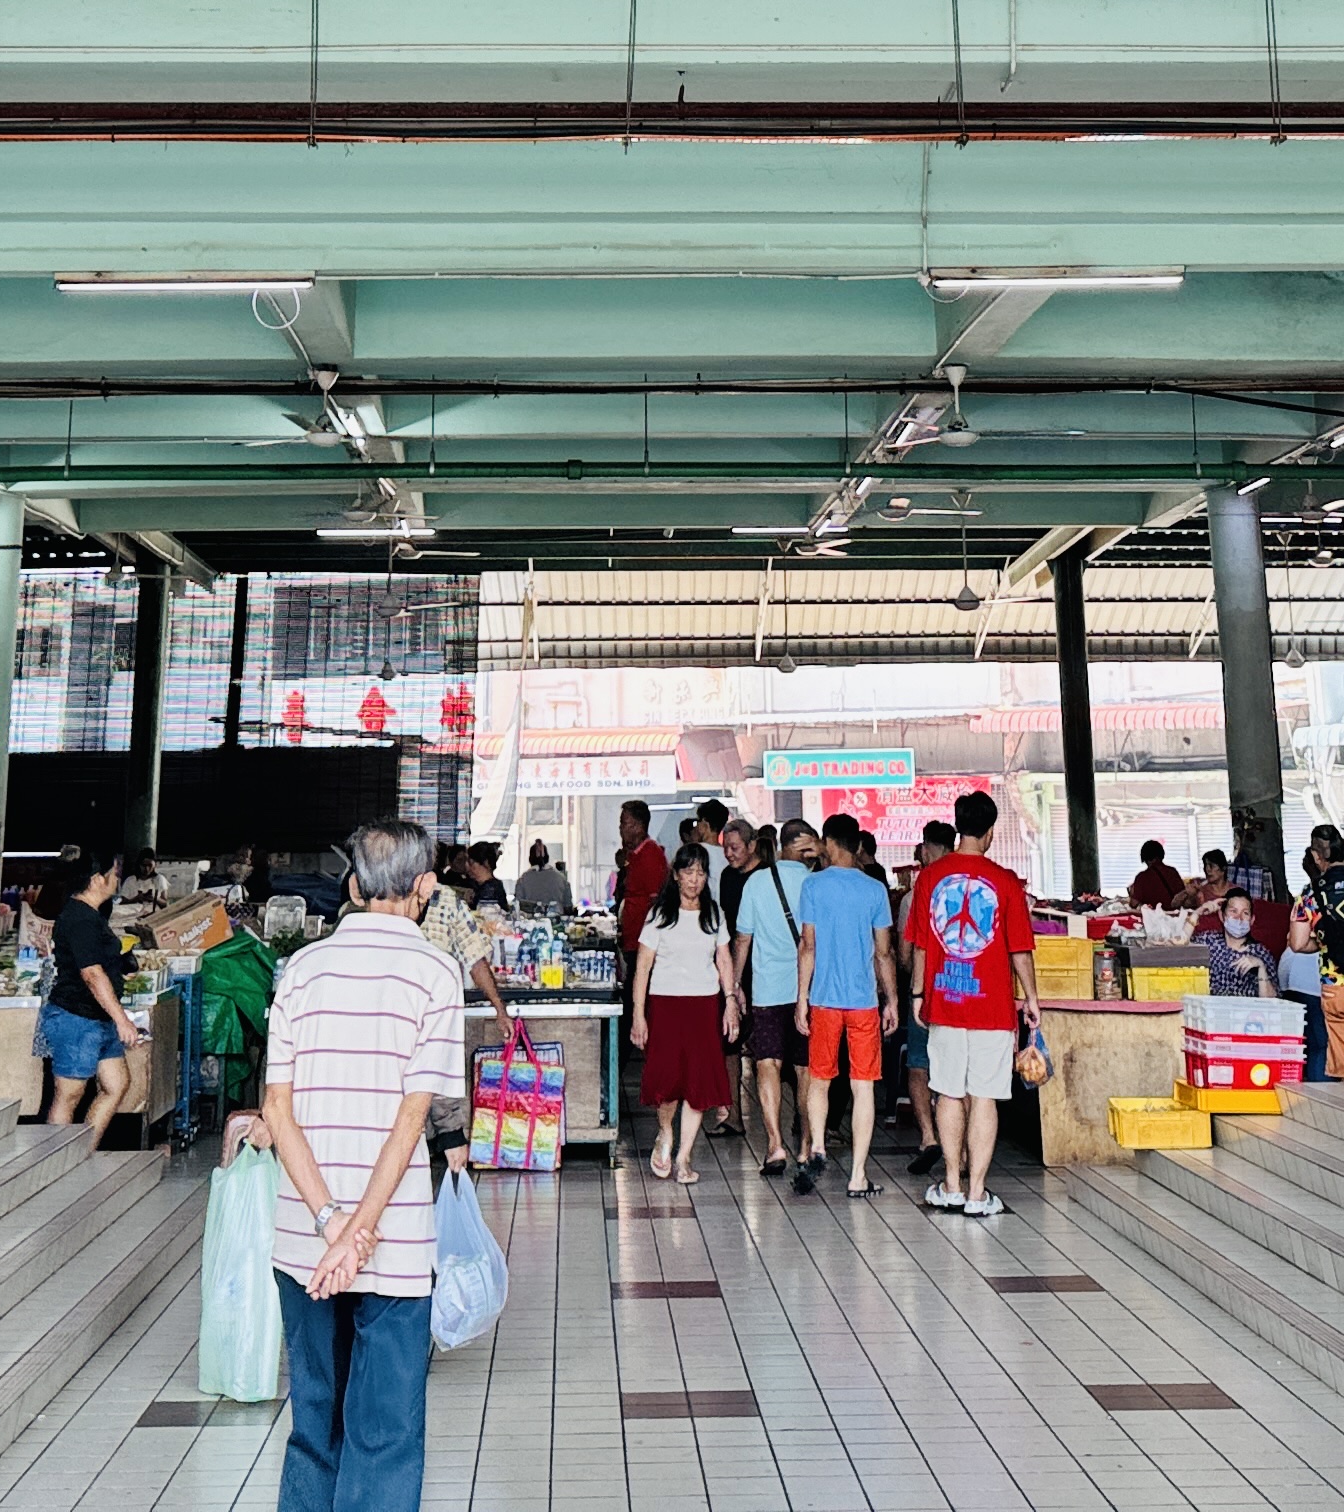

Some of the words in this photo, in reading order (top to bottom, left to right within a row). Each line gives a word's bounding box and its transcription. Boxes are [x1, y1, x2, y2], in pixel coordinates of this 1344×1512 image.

[823, 760, 885, 776] TRADING
[537, 780, 591, 789] SEAFOOD
[877, 817, 922, 829] TUTUP
